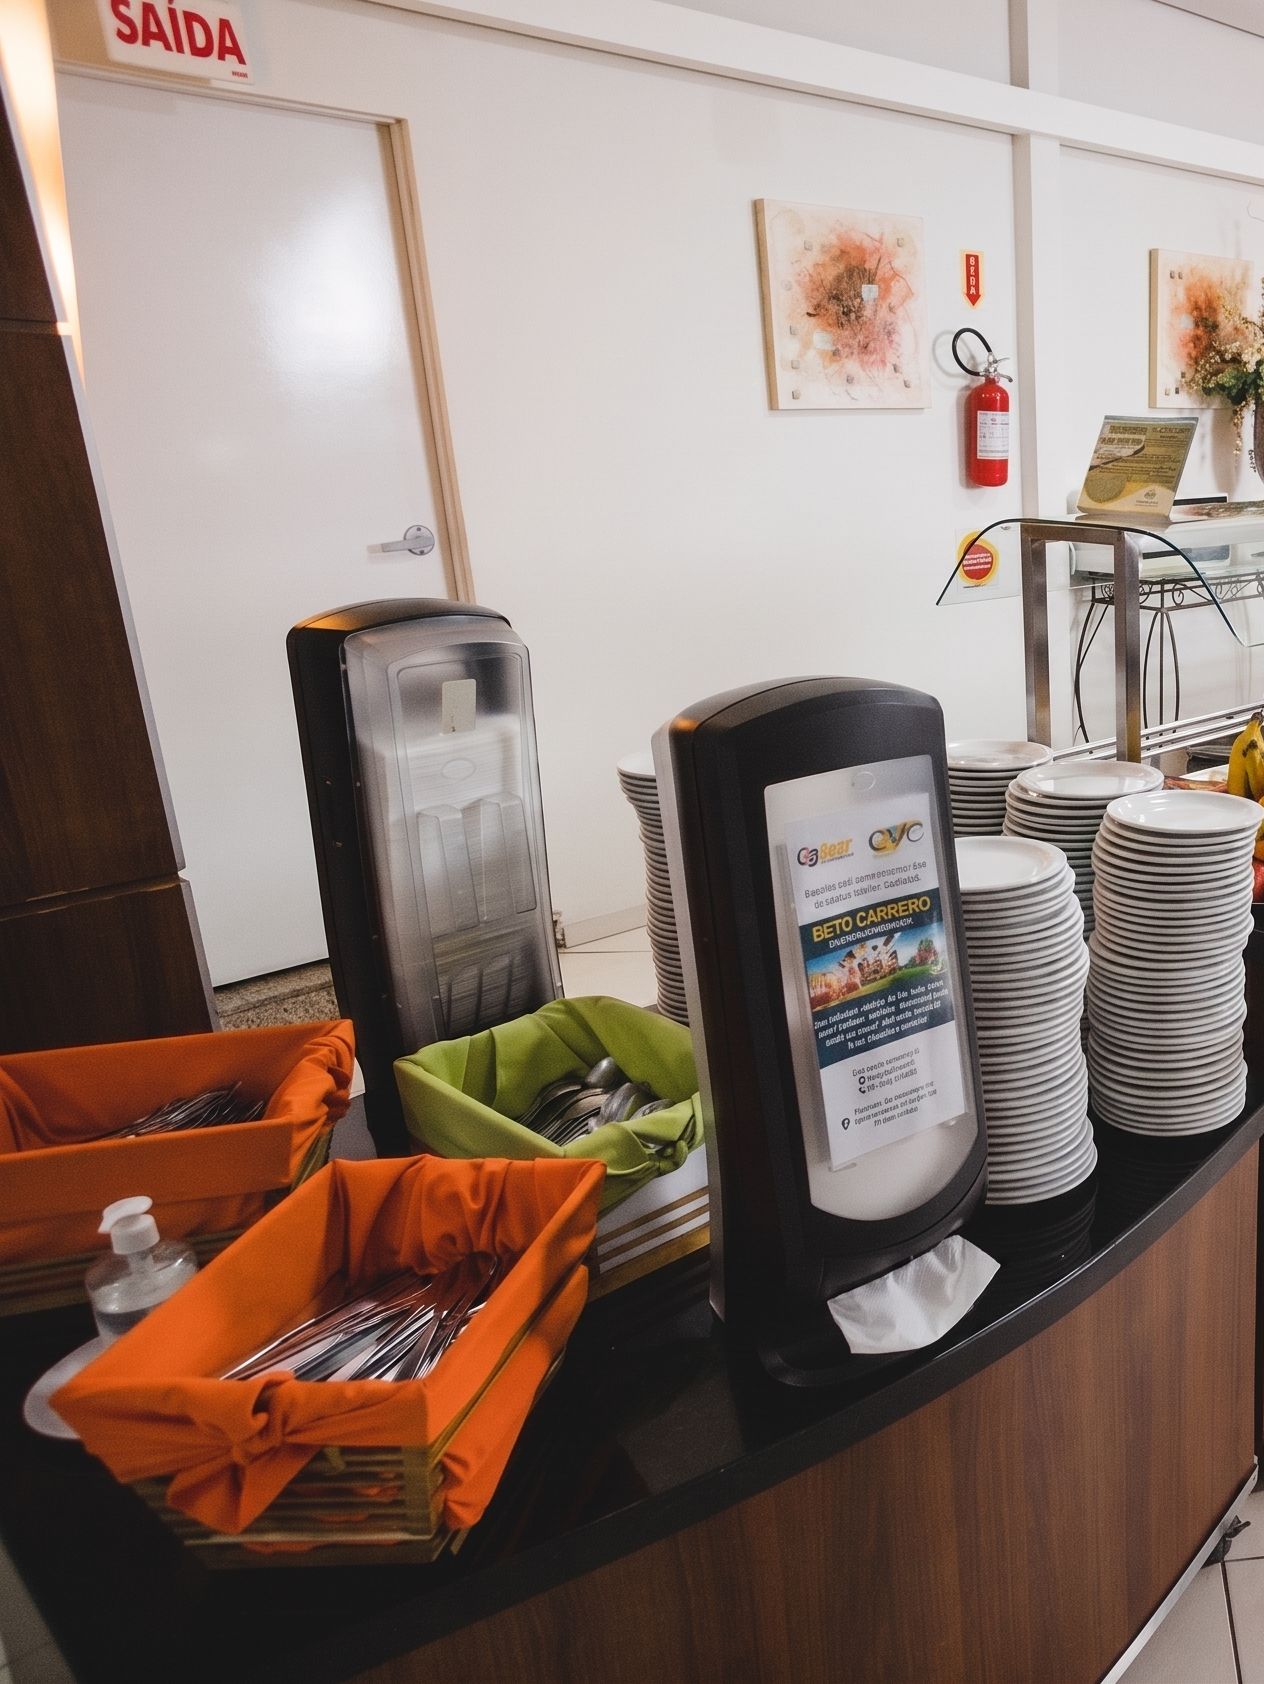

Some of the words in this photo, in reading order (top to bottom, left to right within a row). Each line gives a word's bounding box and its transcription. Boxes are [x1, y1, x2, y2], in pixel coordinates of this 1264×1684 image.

[110, 0, 247, 65] SAÍDA
[812, 916, 853, 943] BETO
[856, 896, 931, 927] CARRERO
